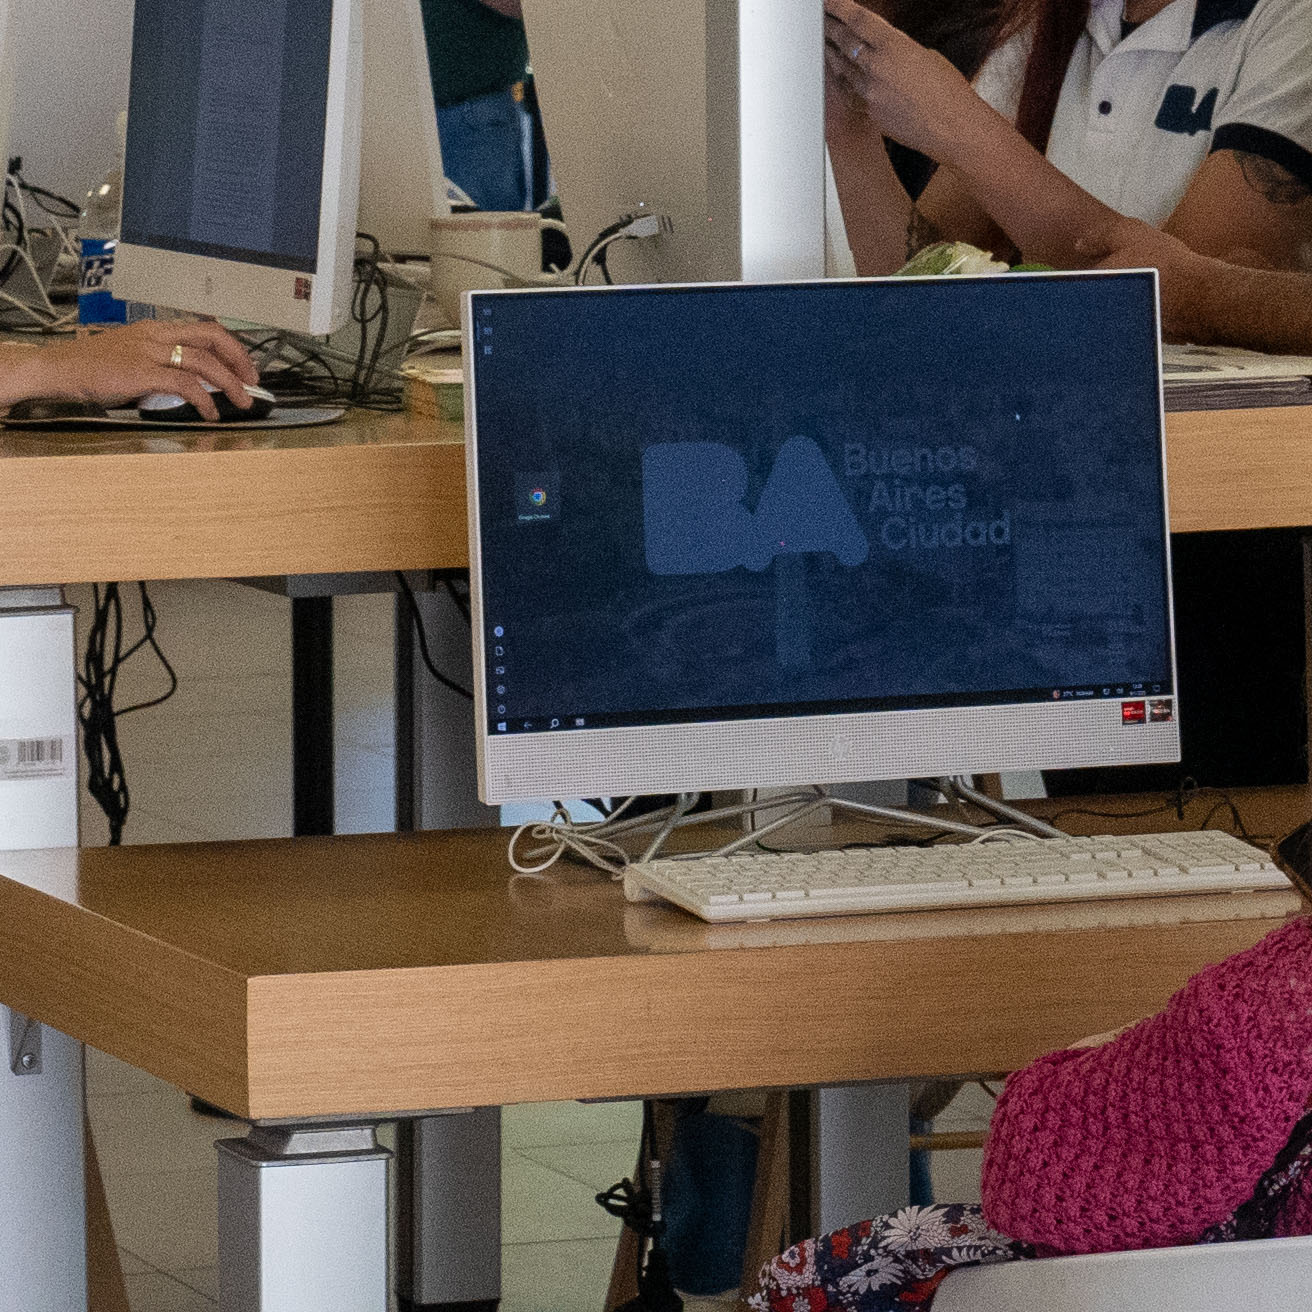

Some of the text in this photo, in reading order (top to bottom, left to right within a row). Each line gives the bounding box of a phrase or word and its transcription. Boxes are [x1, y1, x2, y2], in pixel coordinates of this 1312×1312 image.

[844, 442, 978, 477] Buenos
[641, 435, 870, 576] BA
[868, 480, 967, 513] Aires
[881, 509, 1012, 550] Ciudad
